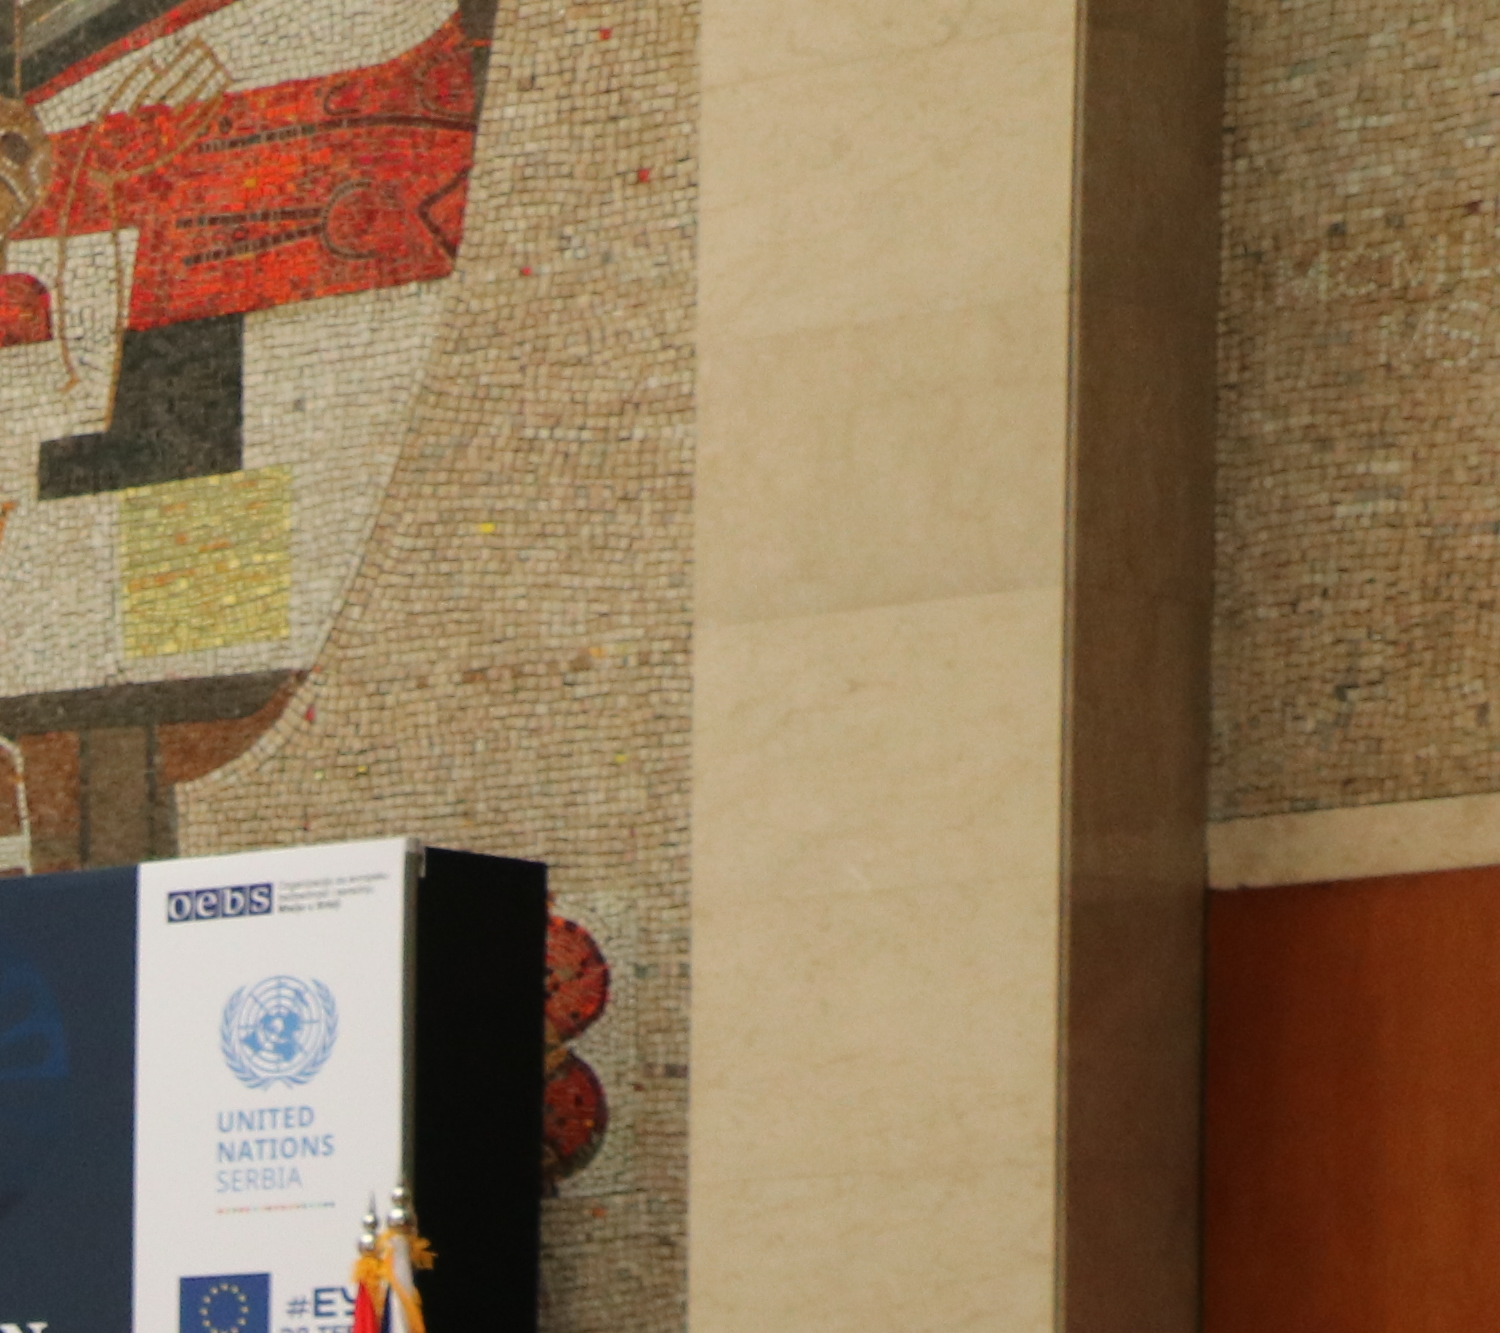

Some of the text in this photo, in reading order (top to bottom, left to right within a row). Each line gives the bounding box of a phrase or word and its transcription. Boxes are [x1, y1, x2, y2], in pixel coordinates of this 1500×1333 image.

[169, 886, 271, 921] oebs
[217, 1106, 315, 1134] UNITED
[216, 1134, 335, 1163] NATIONS
[216, 1164, 302, 1194] SERBIA
